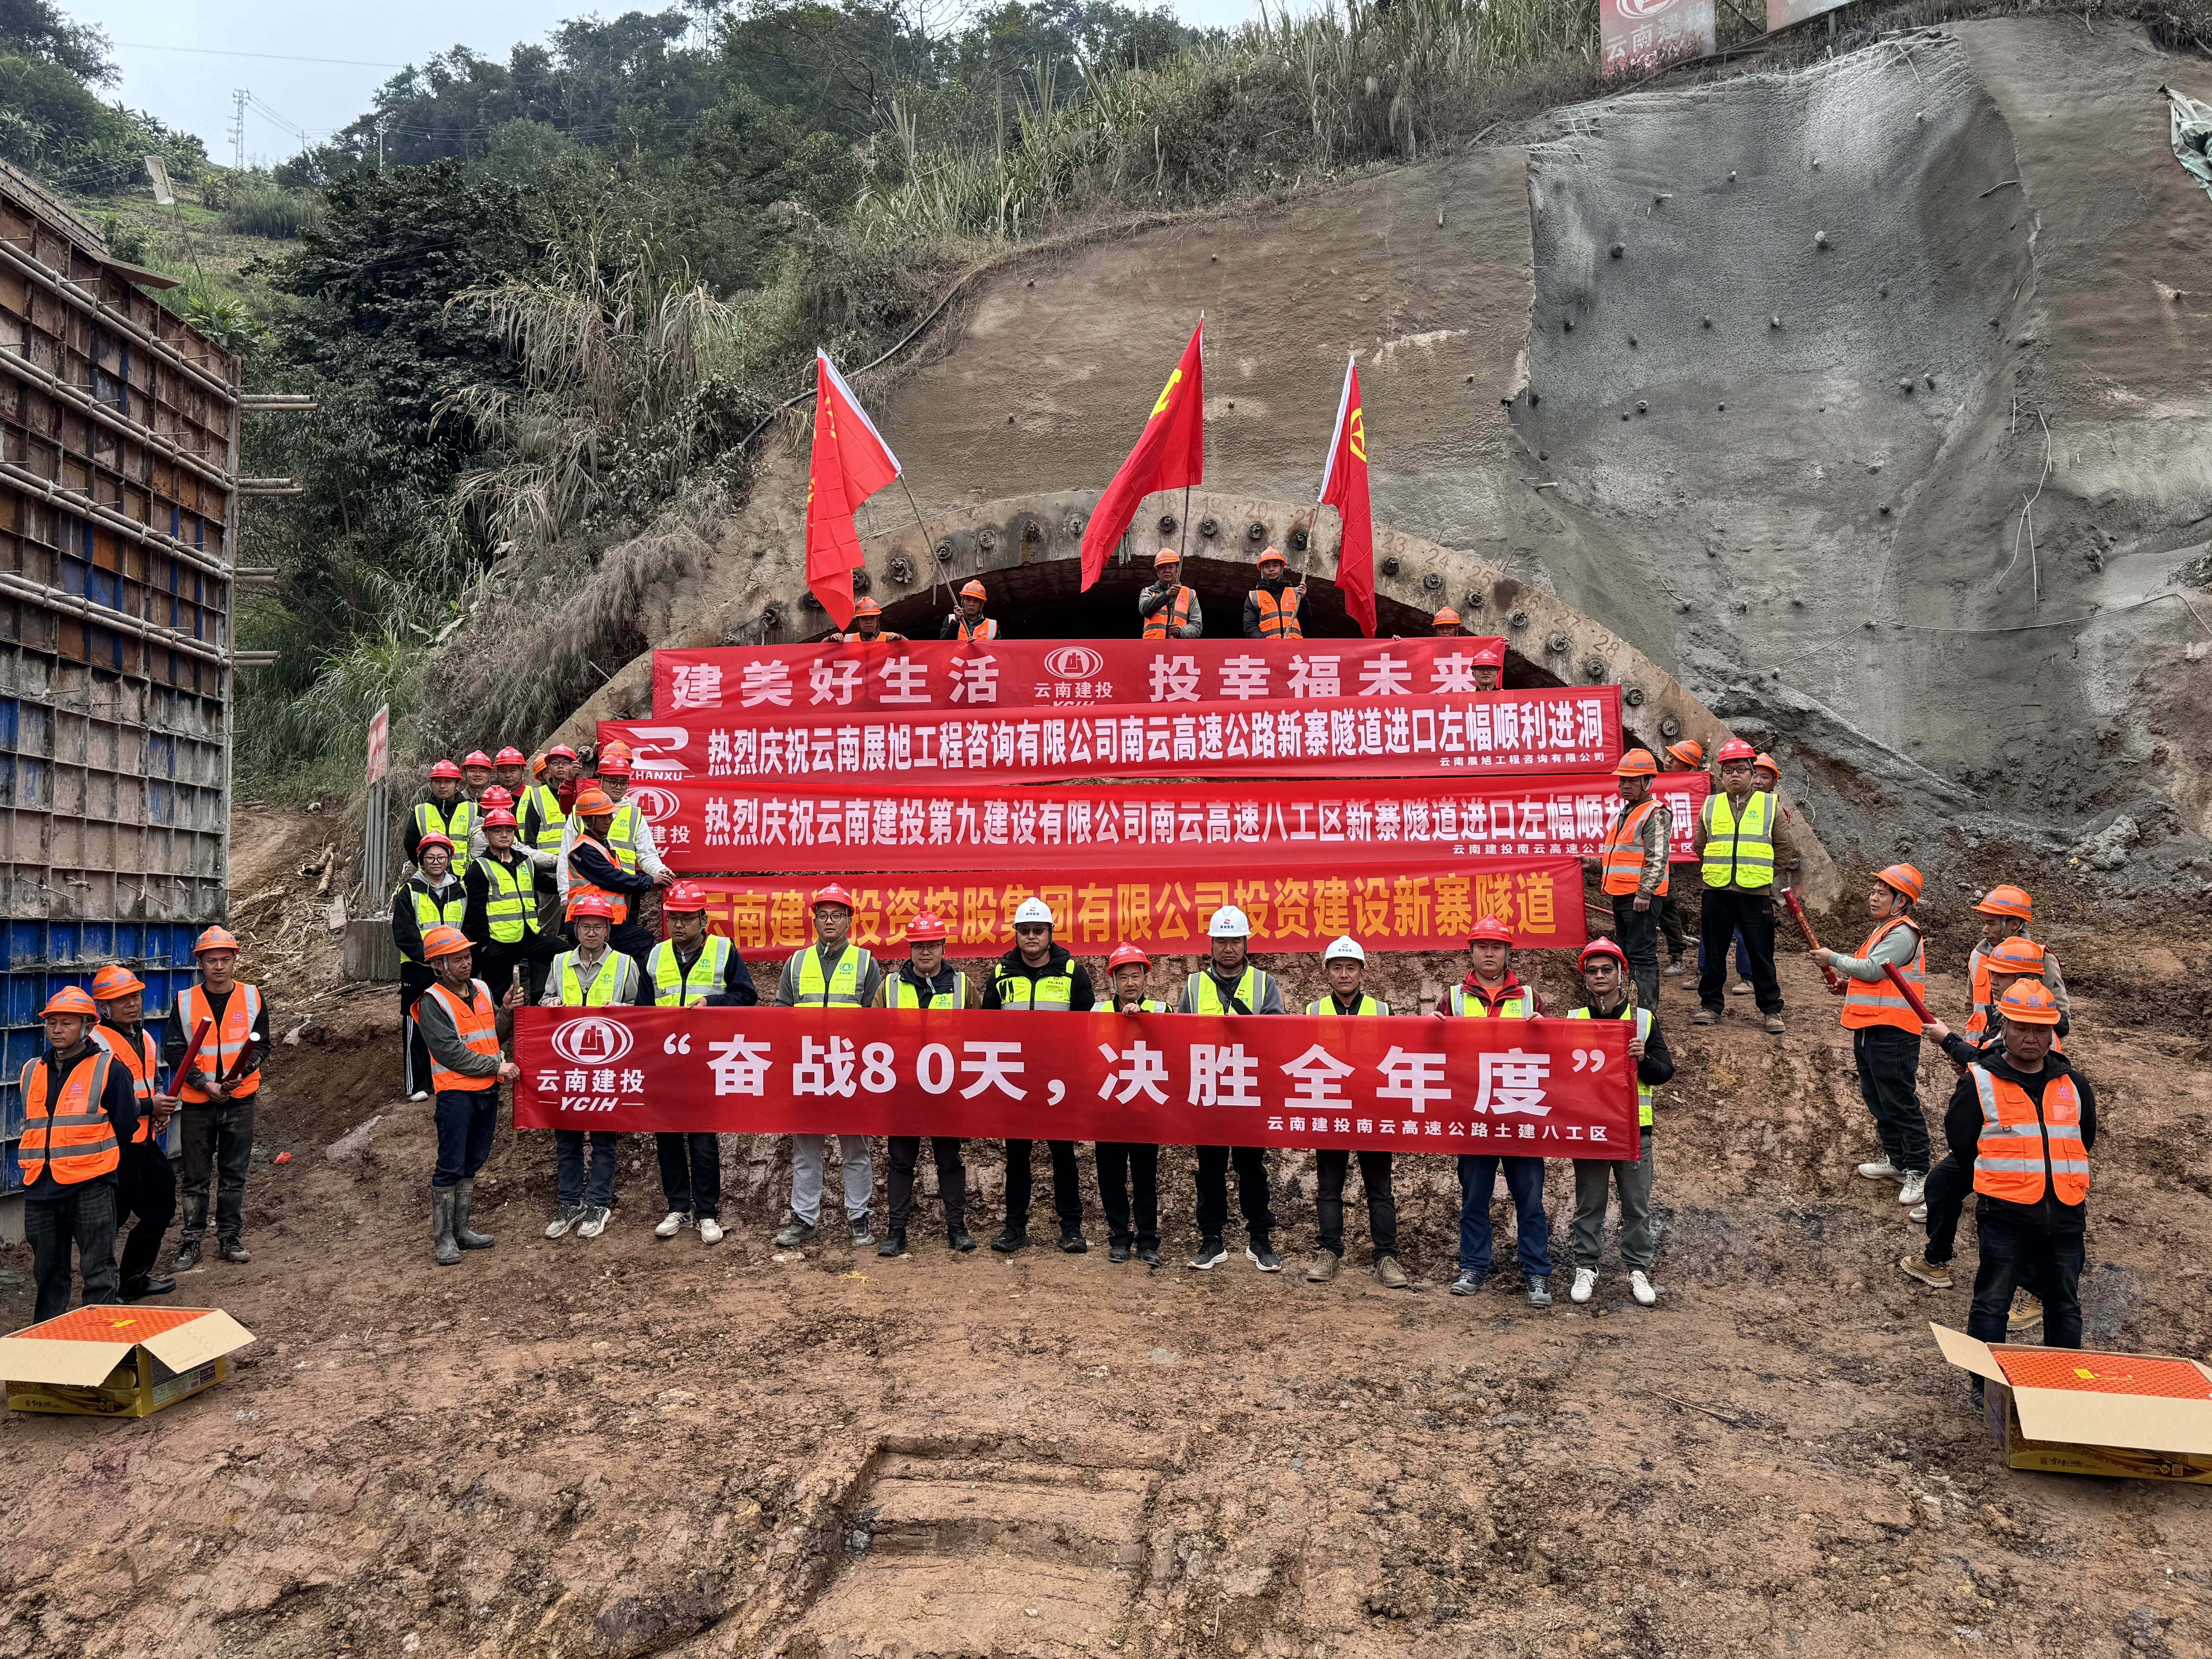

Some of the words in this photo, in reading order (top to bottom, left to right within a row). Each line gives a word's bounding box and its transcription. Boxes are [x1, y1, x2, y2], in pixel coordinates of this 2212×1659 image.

[1245, 500, 1268, 519] 20
[1295, 508, 1316, 527] 21
[1381, 532, 1407, 553] 23
[1425, 548, 1449, 568] 24
[1465, 565, 1494, 589] 25
[1553, 609, 1581, 630] 27
[1592, 634, 1620, 657] 28
[671, 655, 999, 710] 建美好生活
[1149, 653, 1477, 702] 投幸福未来
[1034, 682, 1113, 698] 云南建投
[708, 699, 1603, 776] 热烈庆祝云南展旭工程咨询有限公司南云高速公路新寨隧道进口左幅顺利进洞
[1439, 752, 1604, 767] 云南展旭工程咨询有限公司
[629, 770, 682, 781] ZHANXU
[704, 792, 1693, 846] 热烈庆祝云南建投第九建设有限公司南云高速八工区新寨隧道进口左幅顺利洞
[652, 825, 690, 843] 建投
[1453, 840, 1694, 855] 云南建投南云高速公工区
[706, 871, 1556, 948] 云南建投资控股集团有限公司投资建设新寨隧道
[537, 1068, 645, 1093] 云南建投
[560, 1097, 619, 1111] YCIH
[1267, 1116, 1608, 1142] 云南建投南云高速公路土建八工区
